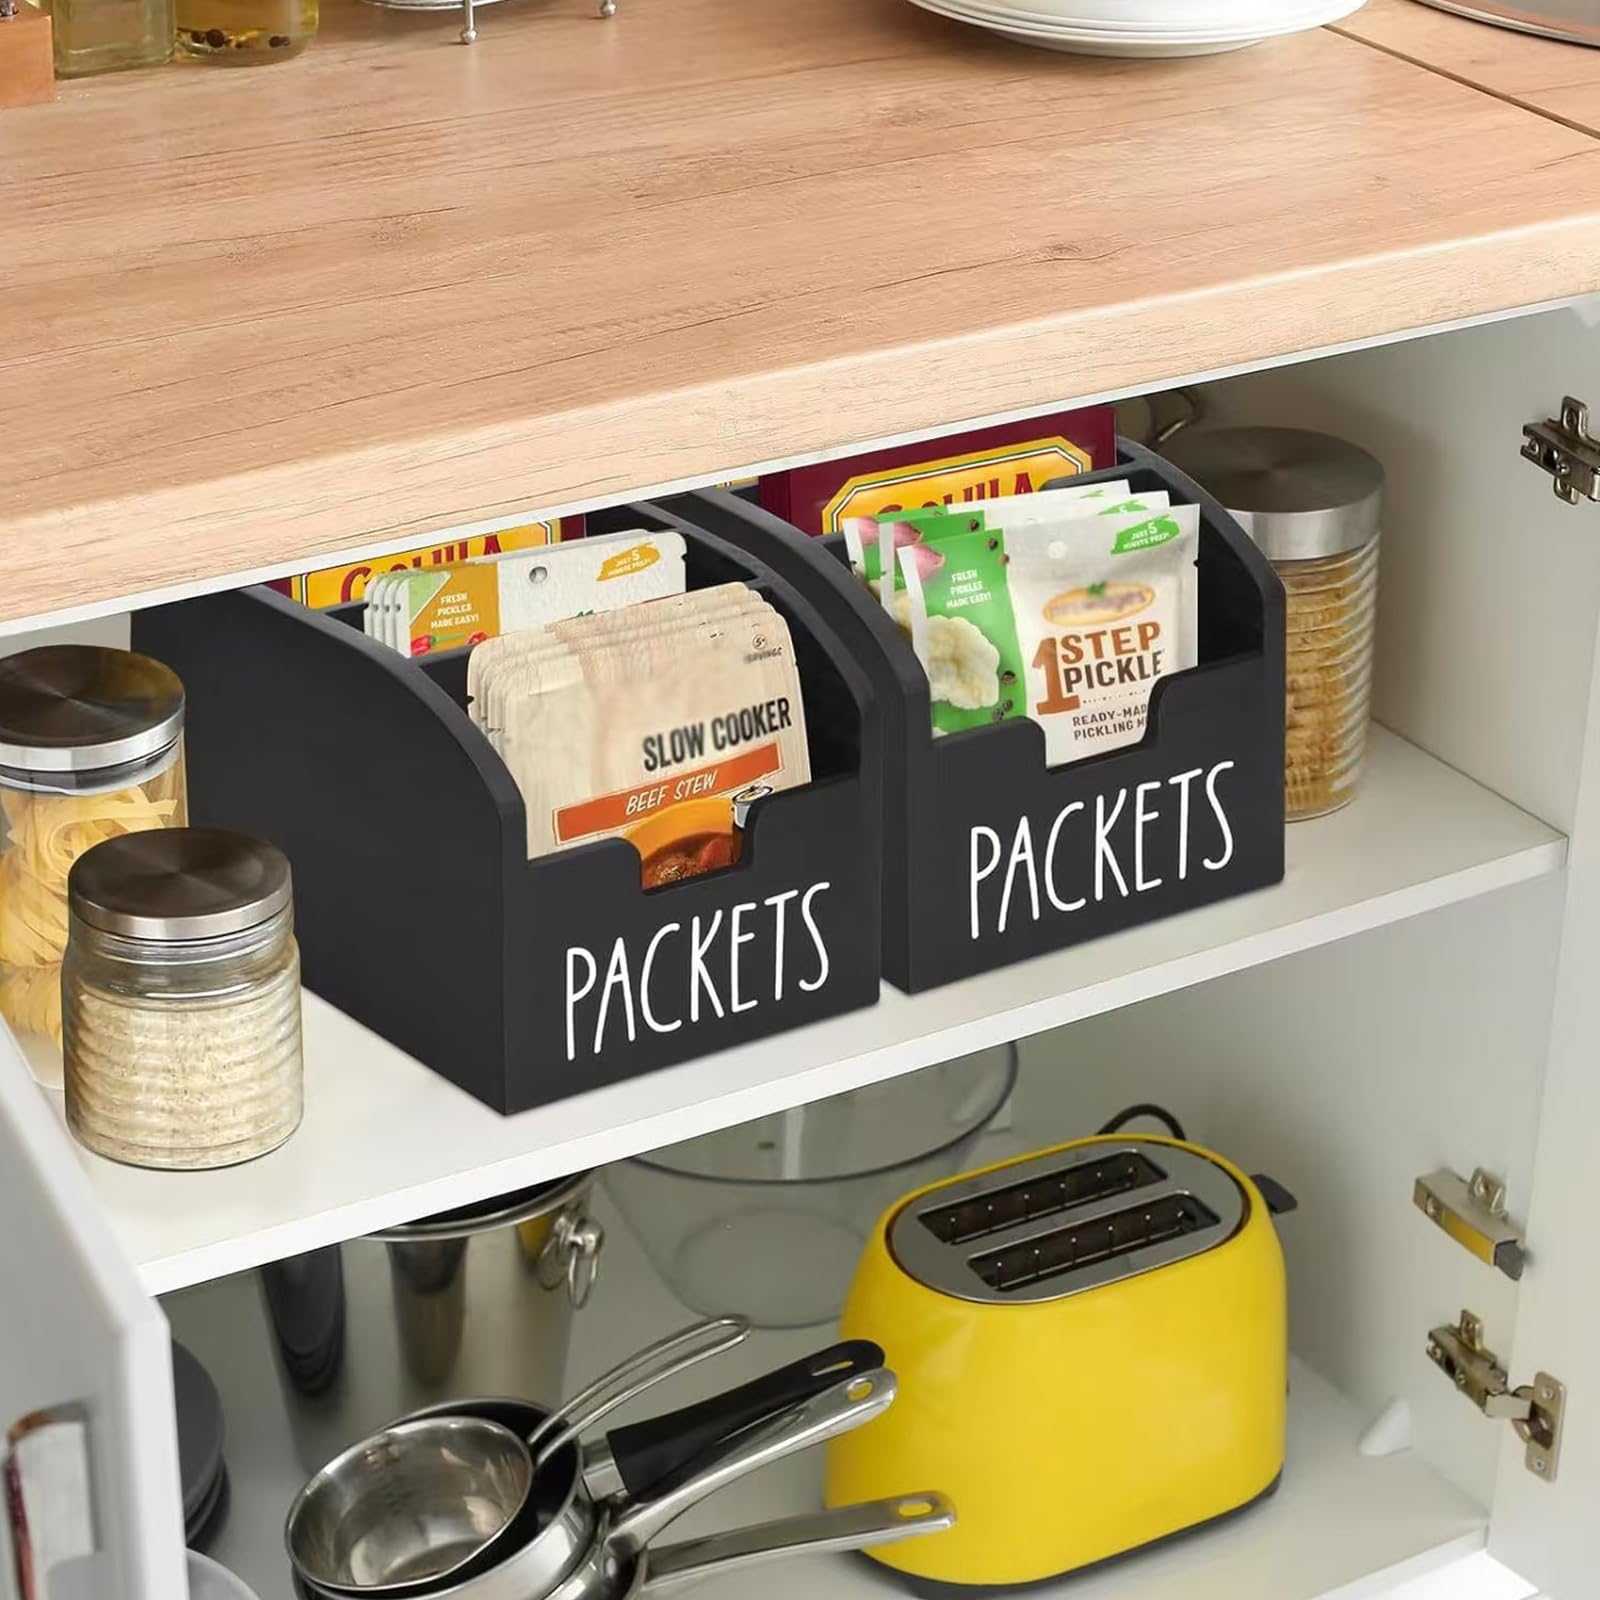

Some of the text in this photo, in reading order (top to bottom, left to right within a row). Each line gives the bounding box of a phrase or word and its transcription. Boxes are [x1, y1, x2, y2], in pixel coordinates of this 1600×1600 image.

[1148, 521, 1158, 534] 5
[631, 549, 641, 561] 5
[952, 569, 978, 583] FRESH
[950, 580, 983, 596] PICKLES
[440, 592, 468, 604] FRESH
[946, 597, 969, 609] MADE
[437, 603, 472, 617] PICKLES
[431, 613, 480, 630] MADE EASY!
[1032, 621, 1161, 715] 1 STEP
[1063, 650, 1163, 693] PICKLE
[643, 697, 792, 772] SLOW COOKER
[1074, 720, 1134, 740] PICKLING
[625, 769, 719, 815] BEEF STEW
[968, 760, 1234, 941] PACKETS
[566, 882, 832, 1061] PACKETS
